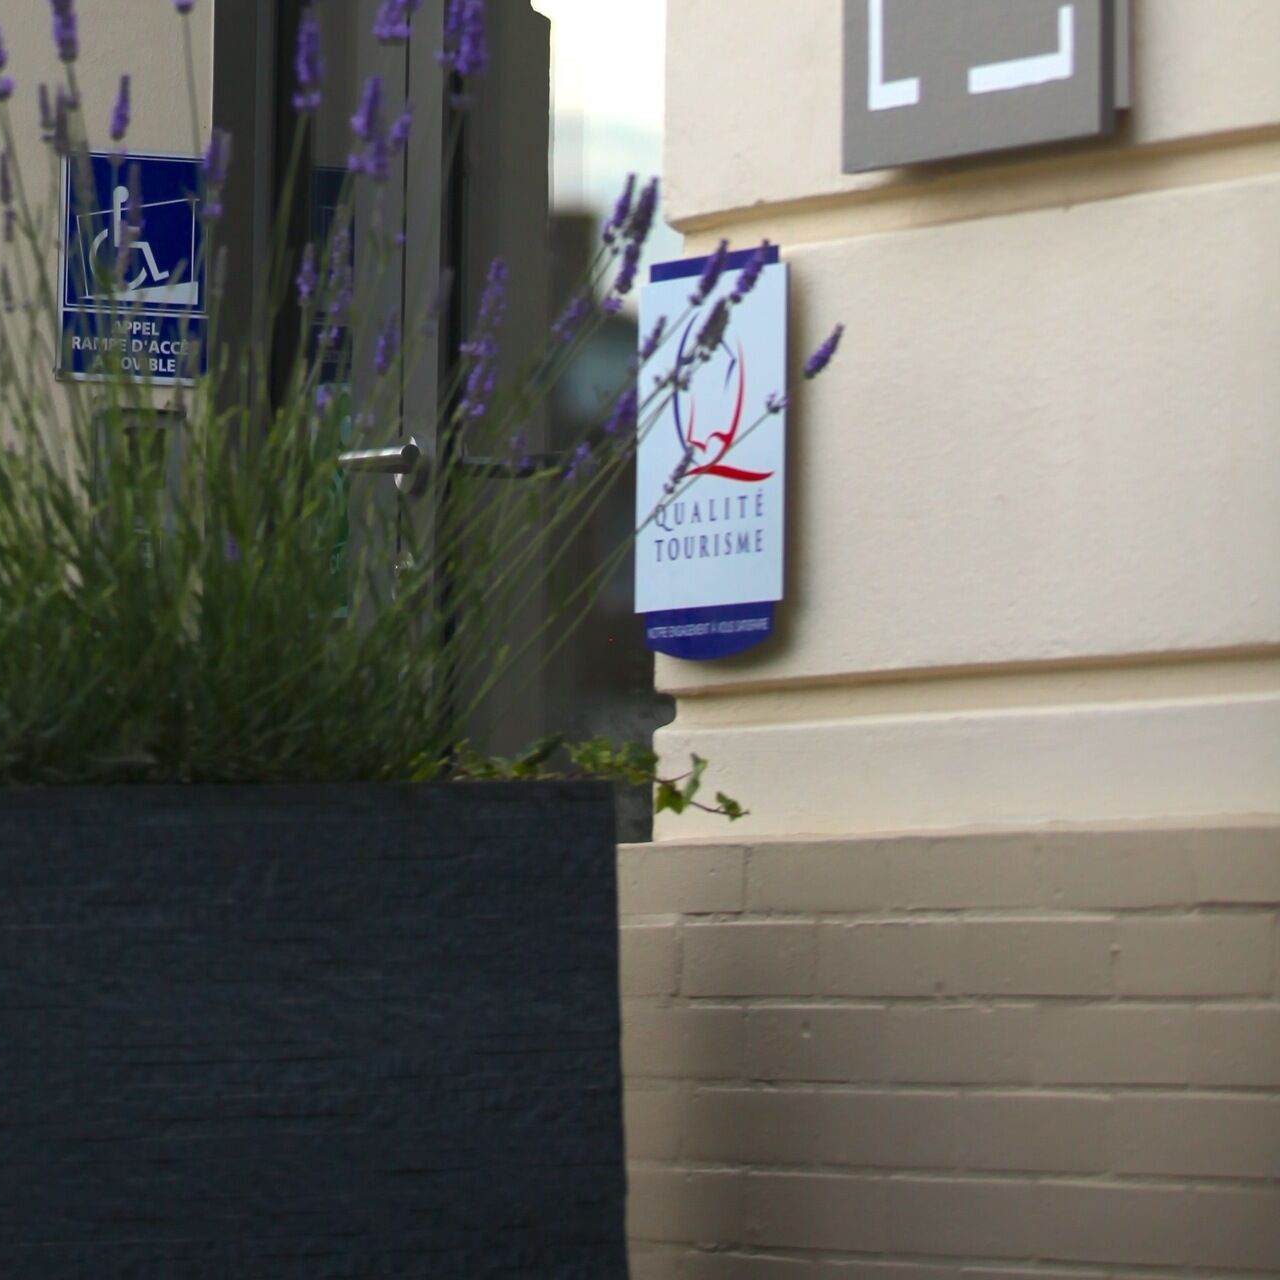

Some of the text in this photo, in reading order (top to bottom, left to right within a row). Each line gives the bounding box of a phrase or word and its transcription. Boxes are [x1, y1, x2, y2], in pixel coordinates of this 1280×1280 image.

[92, 355, 176, 373] AOVBLE
[654, 488, 764, 532] QUALITÉ
[654, 528, 764, 563] TOURISME
